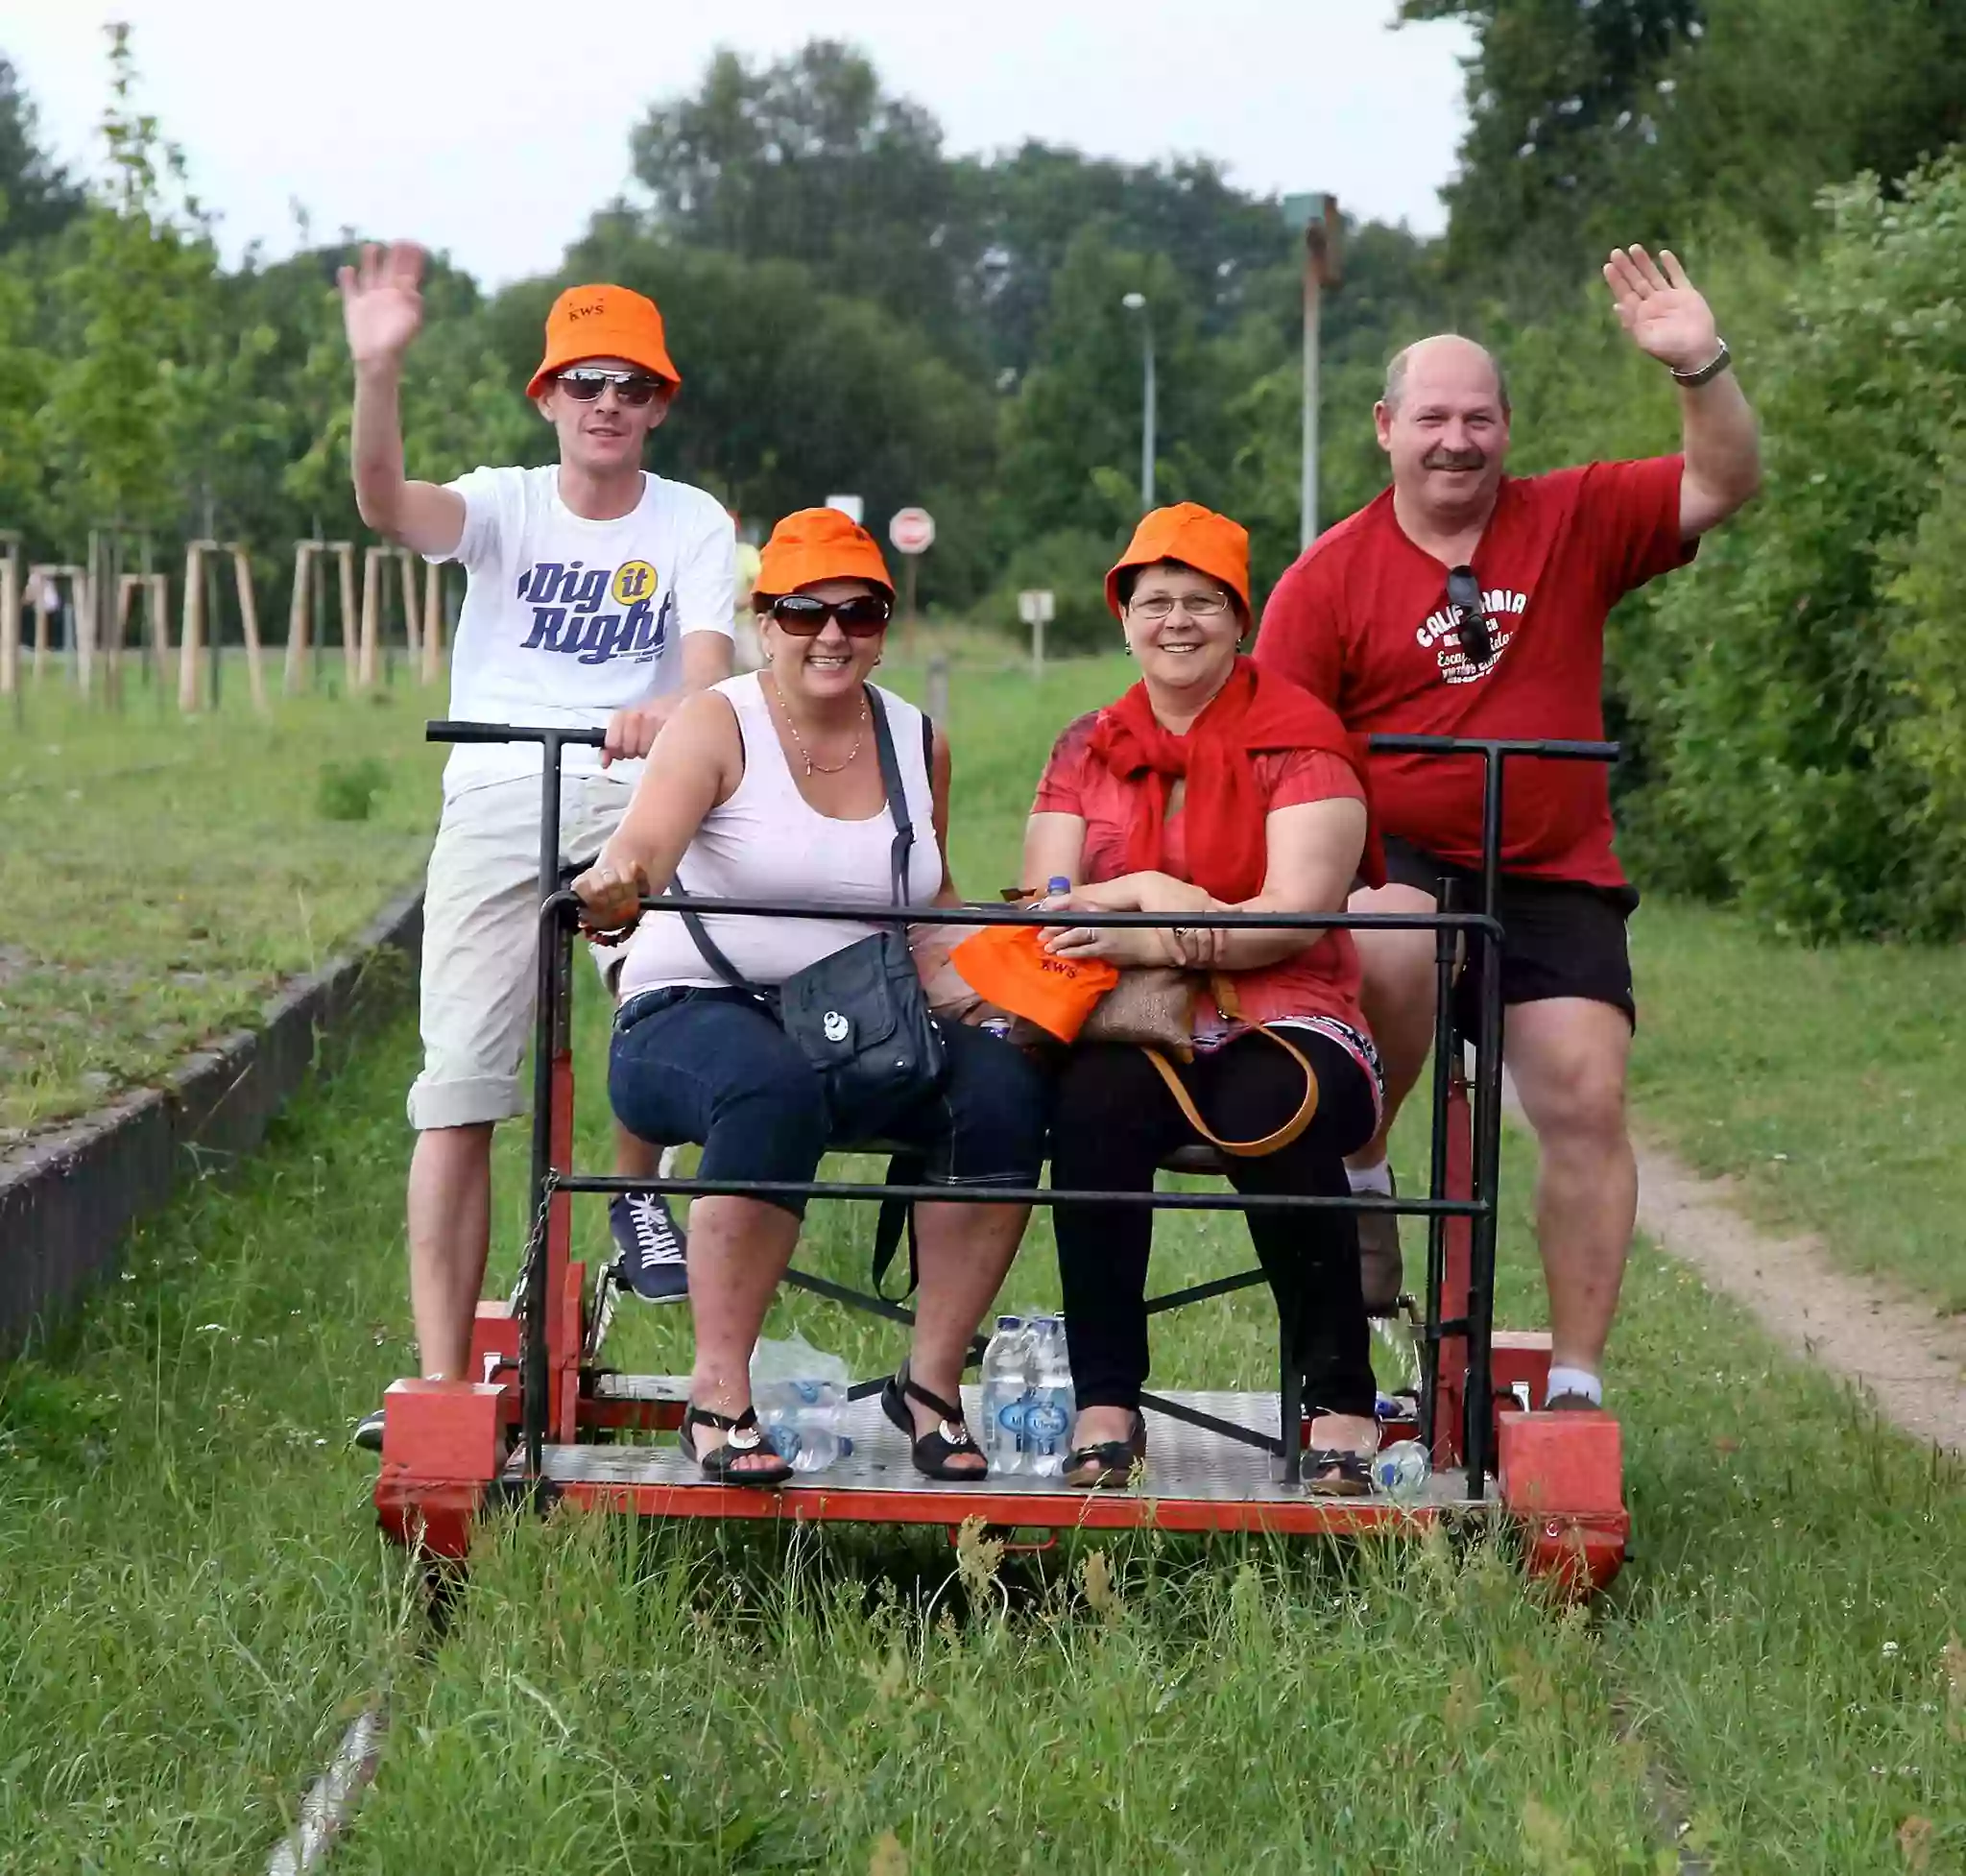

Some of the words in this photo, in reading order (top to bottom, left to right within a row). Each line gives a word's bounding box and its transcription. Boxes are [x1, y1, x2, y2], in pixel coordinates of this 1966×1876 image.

[518, 560, 612, 613] Dig
[621, 566, 649, 598] it
[519, 590, 672, 664] Right
[1416, 589, 1527, 648] CALIFRNIA
[1042, 958, 1077, 979] KWS
